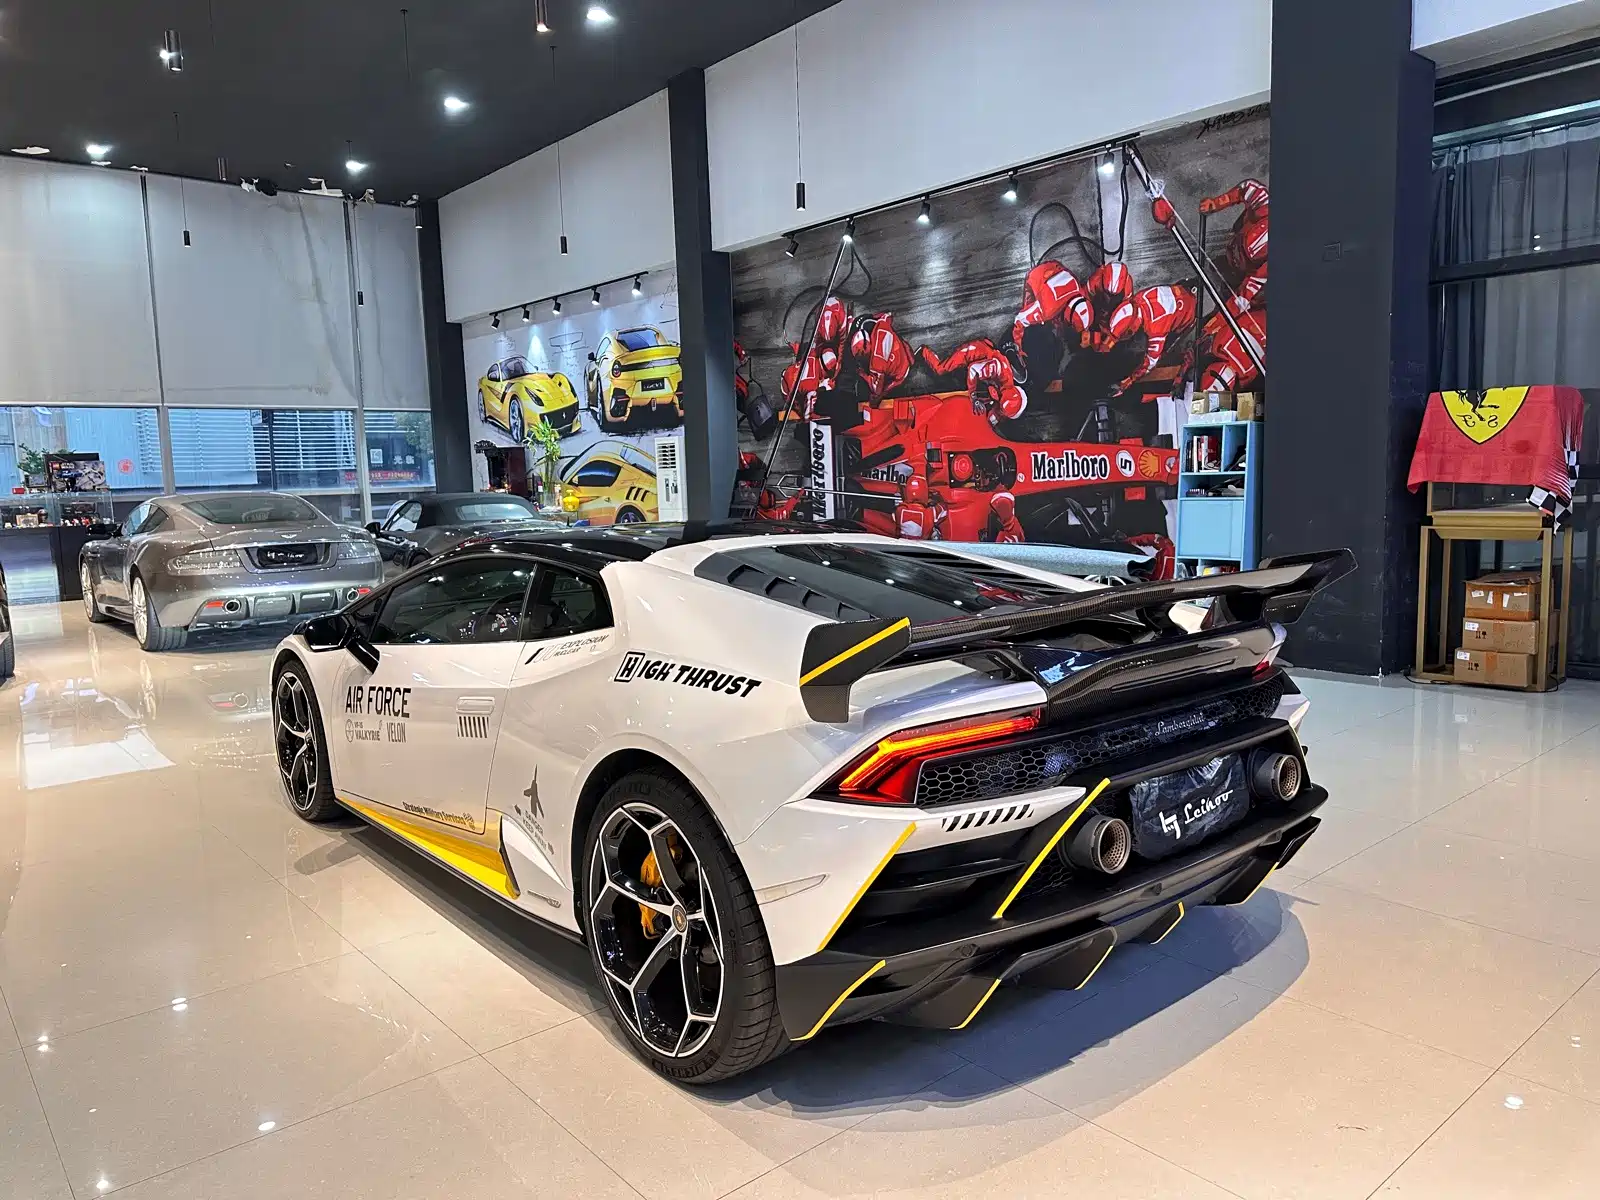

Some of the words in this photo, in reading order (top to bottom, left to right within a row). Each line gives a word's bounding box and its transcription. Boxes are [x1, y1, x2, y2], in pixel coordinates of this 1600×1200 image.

[1032, 451, 1110, 481] Marlboro
[614, 651, 676, 682] HIGH
[672, 664, 763, 698] THRUST
[345, 685, 364, 714] AIR
[367, 686, 412, 718] FORCE
[354, 729, 381, 742] VALKYRIE
[386, 722, 407, 743] VELON
